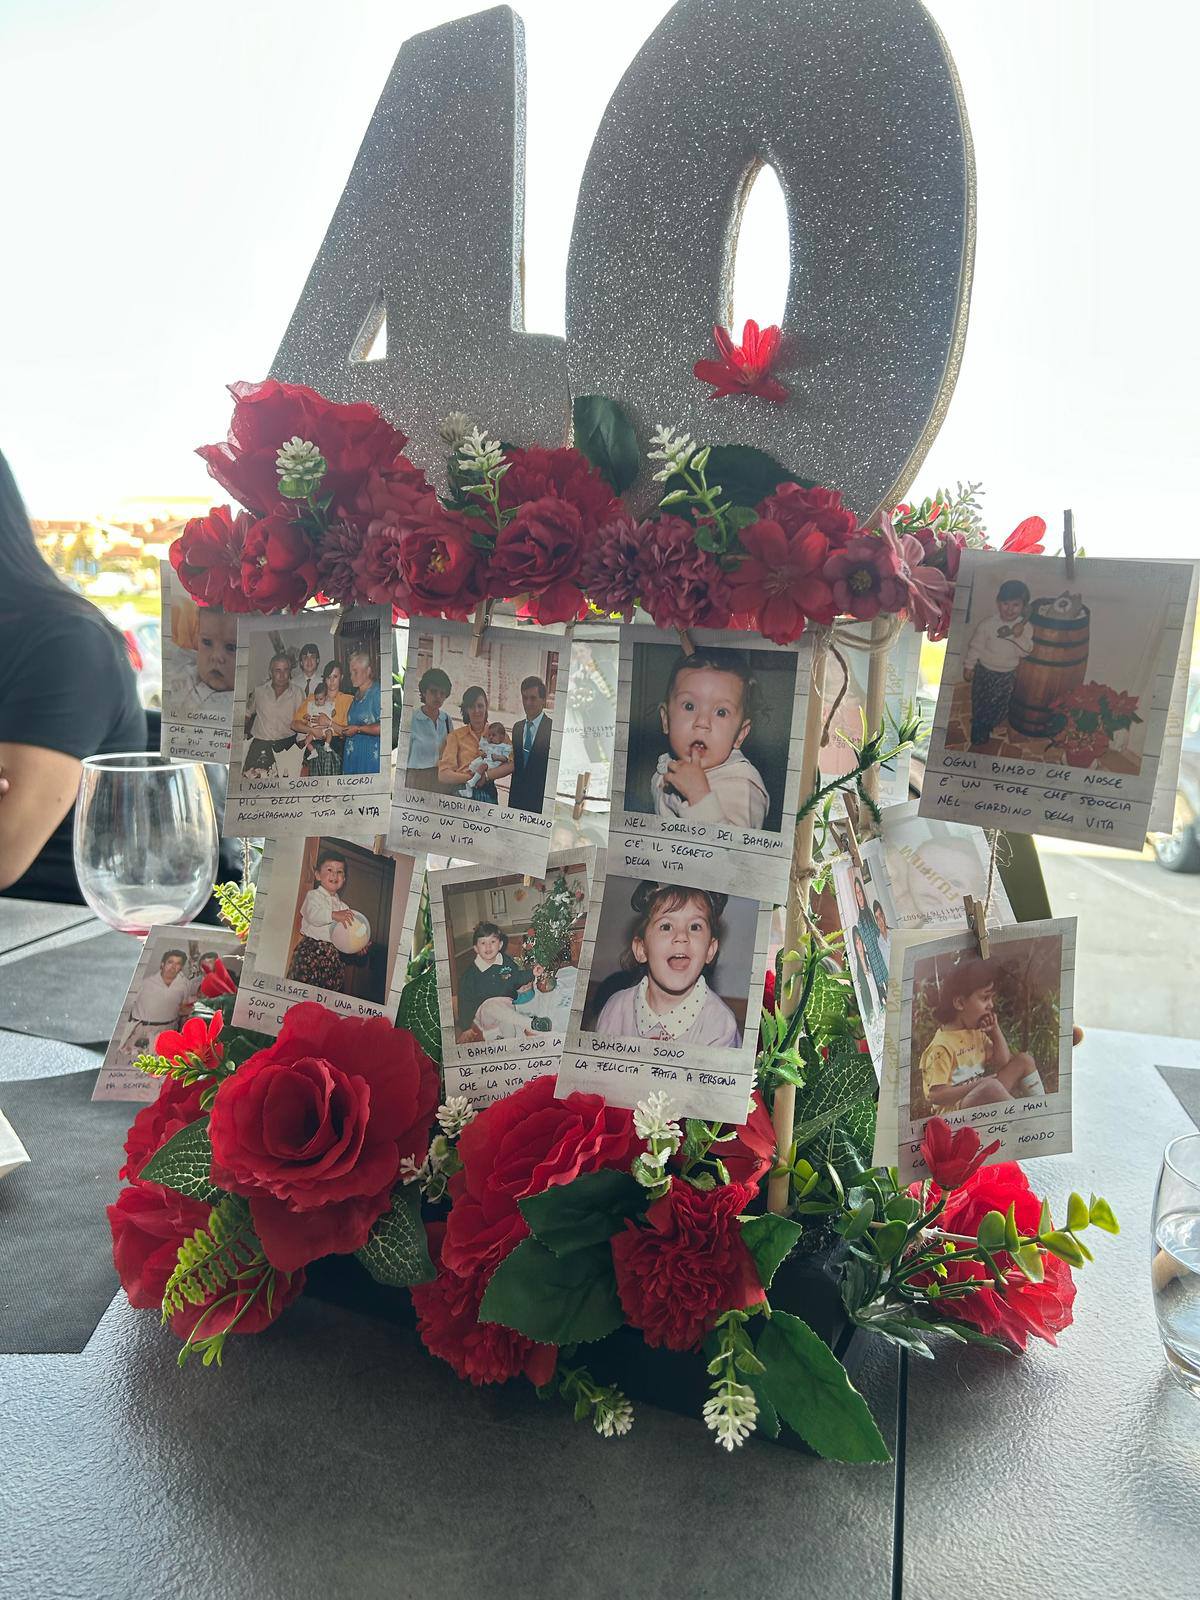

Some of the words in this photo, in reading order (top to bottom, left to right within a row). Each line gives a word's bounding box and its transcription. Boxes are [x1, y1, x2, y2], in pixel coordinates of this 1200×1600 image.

[266, 0, 977, 518] 40
[943, 756, 977, 769] OGNI
[992, 762, 1036, 777] BIMBO
[1046, 769, 1072, 781] CHE
[249, 782, 280, 790] NONNI
[289, 780, 319, 790] SONO
[337, 776, 374, 786] RICORDI
[271, 796, 300, 805] BELLI
[311, 795, 332, 803] CHE
[342, 794, 355, 802] CI
[962, 778, 981, 789] UN
[993, 782, 1030, 796] FIORE
[1043, 790, 1069, 801] CHE
[1080, 796, 1132, 811] SBOCCIA
[237, 810, 303, 822] ACCOMPAGNANO
[313, 808, 336, 818] TUTTA
[344, 808, 354, 816] LA
[358, 806, 380, 817] VITA
[405, 794, 425, 804] UNA
[438, 799, 481, 813] MADRINA
[519, 813, 553, 828] PADRINO
[938, 795, 961, 807] NEL
[974, 801, 1032, 817] GIARDINO
[1044, 809, 1074, 823] DELLA
[1086, 817, 1115, 831] VITA
[401, 812, 430, 824] SONO
[440, 817, 455, 827] UN
[463, 821, 491, 833] DONO
[401, 825, 422, 837] PER
[431, 832, 442, 840] LA
[450, 835, 474, 845] VITA
[624, 818, 646, 828] NEL
[661, 822, 707, 836] SORRISO
[717, 830, 733, 842] DEI
[743, 833, 784, 849] BAMBINI
[652, 842, 664, 852] IL
[671, 844, 713, 859] SEGRETO
[625, 855, 650, 867] DELLA
[662, 861, 684, 871] VITA
[248, 997, 276, 1009] SONO
[253, 978, 265, 988] LE
[276, 984, 309, 999] RISATE
[316, 993, 327, 1003] DI
[334, 999, 352, 1010] UNA
[358, 1005, 383, 1018] BIMBA
[468, 1045, 507, 1058] BAMBINI
[519, 1040, 546, 1052] SONO
[553, 1038, 562, 1047] LA
[592, 1039, 641, 1053] BAMBINI
[653, 1047, 685, 1058] SONO
[527, 1059, 552, 1069] LORO
[575, 1059, 588, 1070] LA
[651, 1066, 677, 1080] FATTA
[686, 1074, 693, 1082] A
[699, 1073, 737, 1086] PERSONA
[459, 1082, 478, 1092] CHE
[487, 1079, 498, 1088] LA
[505, 1077, 524, 1087] VITA
[971, 1110, 997, 1121] SONO
[1004, 1105, 1016, 1114] LE
[1023, 1100, 1048, 1112] MANI
[988, 1124, 1008, 1134] CHE
[1018, 1131, 1055, 1144] MONDO
